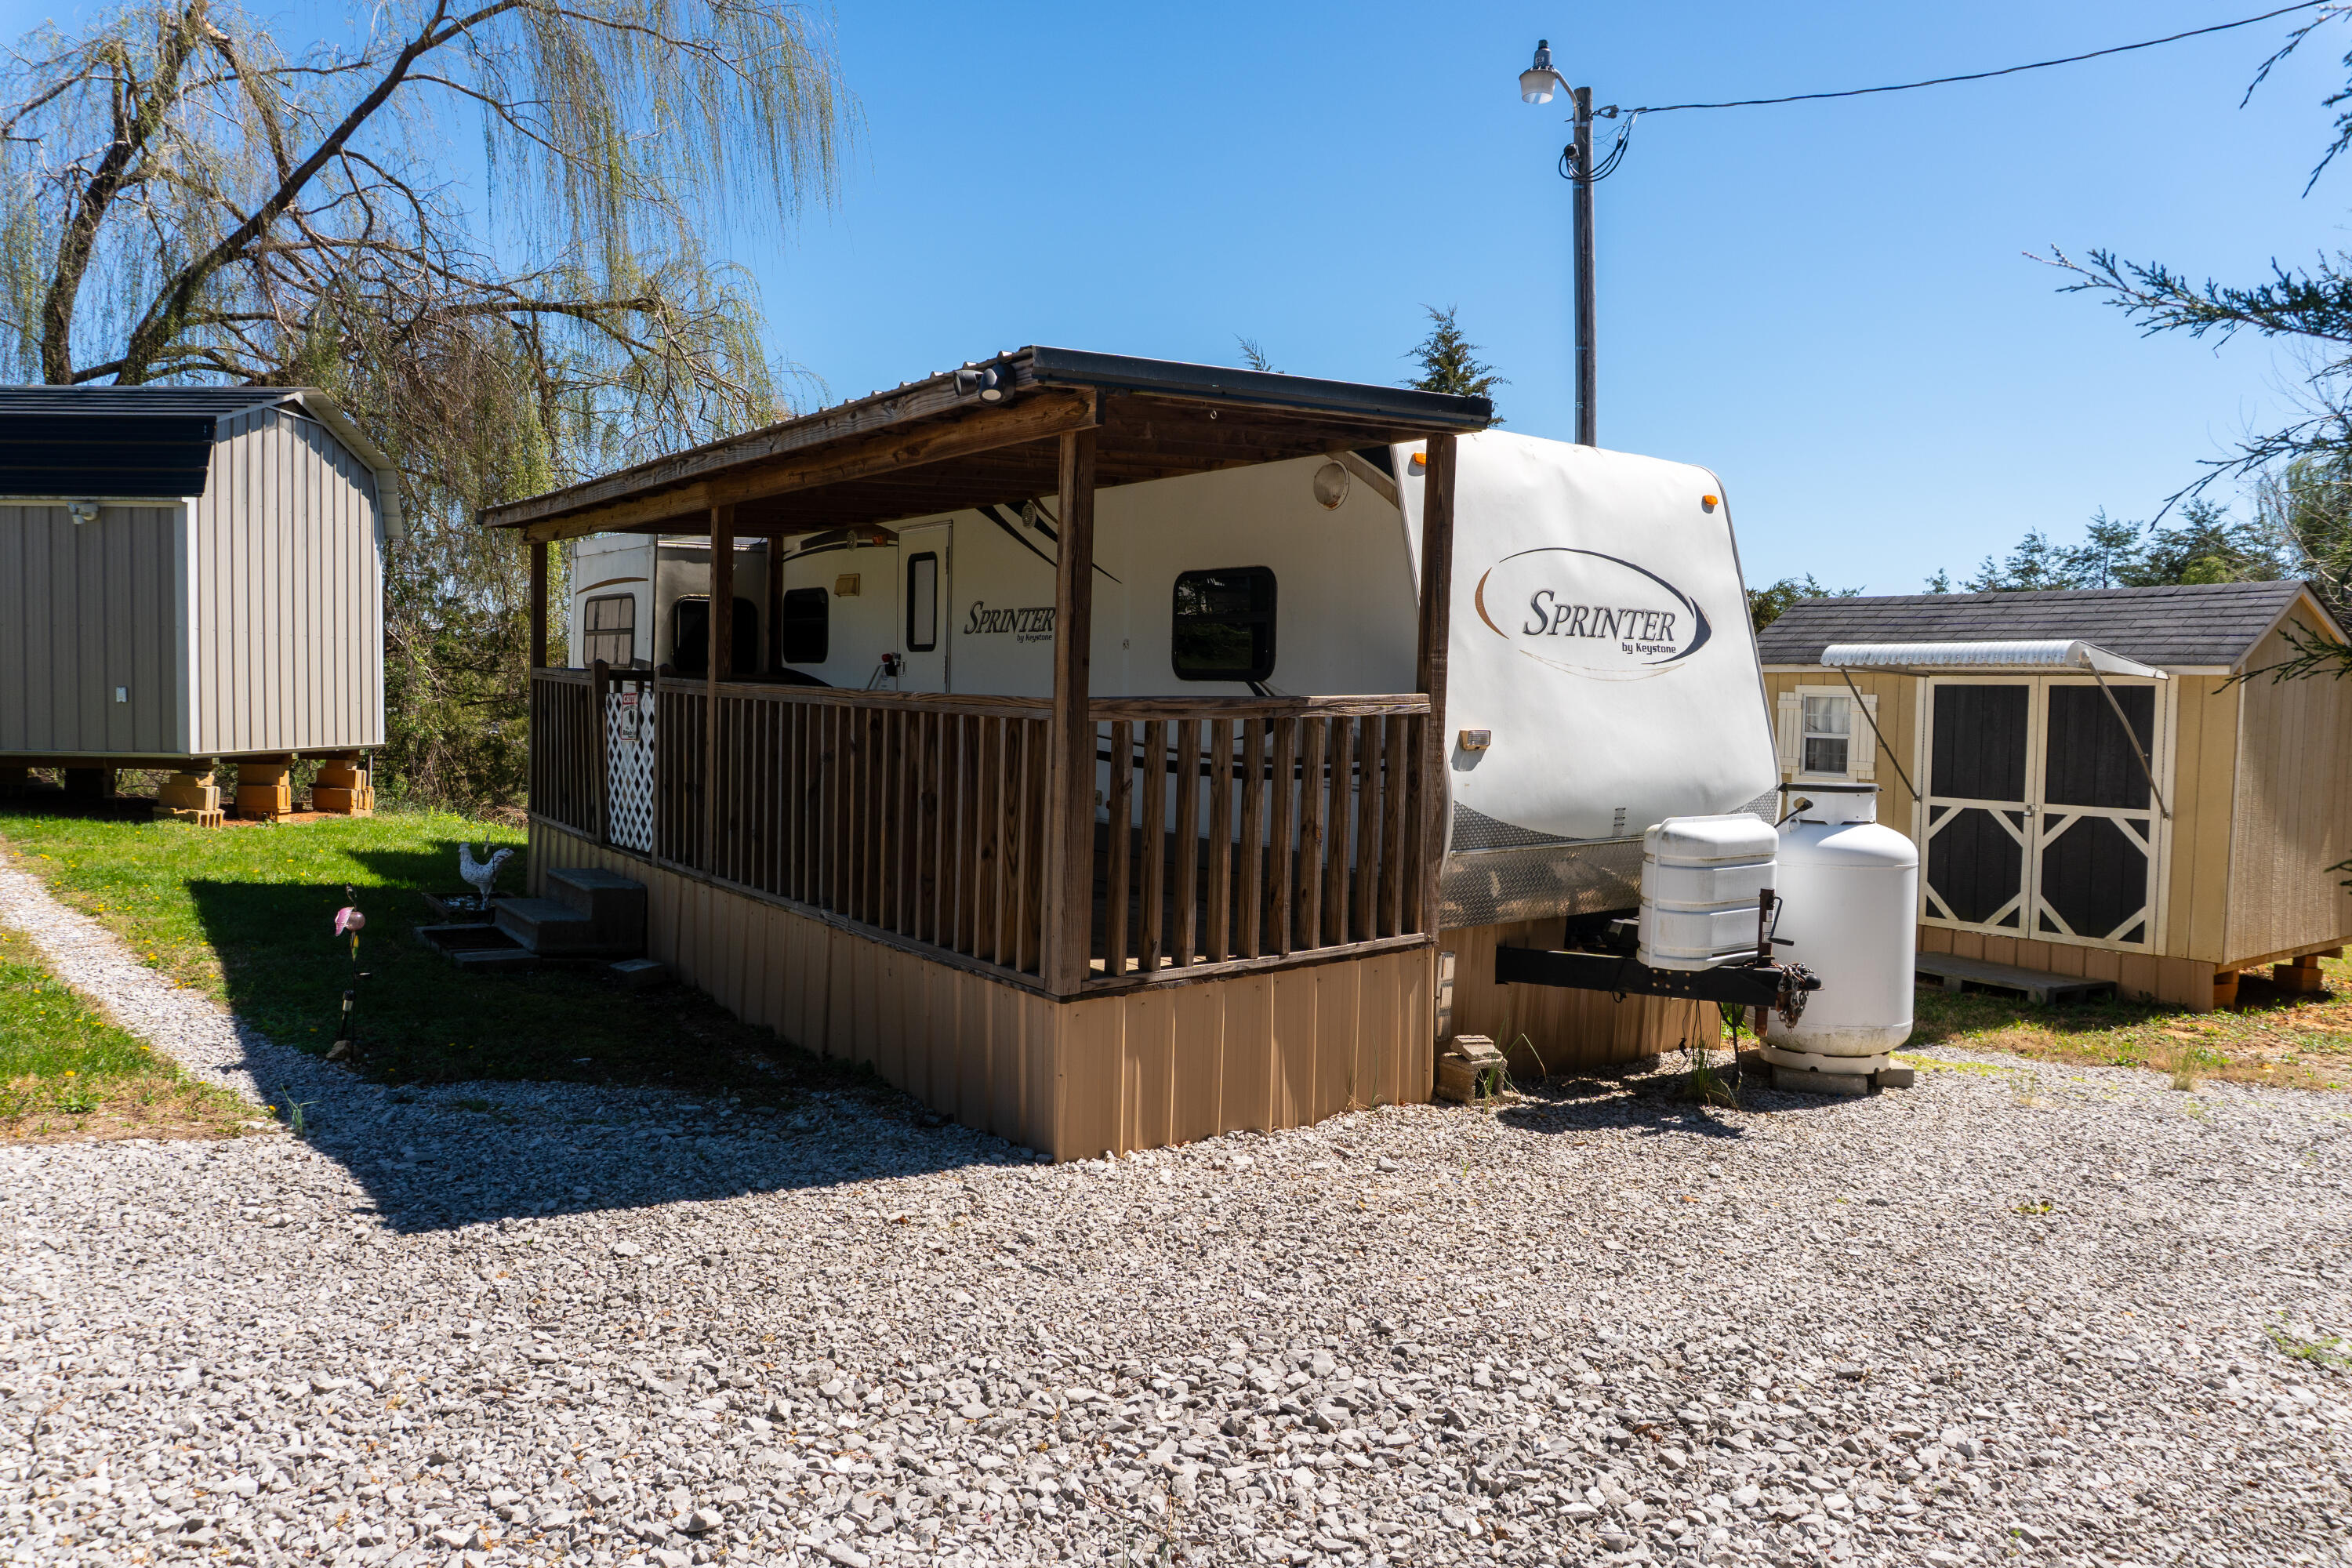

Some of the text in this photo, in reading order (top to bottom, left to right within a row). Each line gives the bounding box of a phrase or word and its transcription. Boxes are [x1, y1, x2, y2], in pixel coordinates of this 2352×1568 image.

[964, 601, 1056, 634] SPRINTER
[1523, 589, 1675, 641] SPRINTER
[1017, 633, 1052, 643] by Keystone
[1622, 642, 1676, 655] by Keystone
